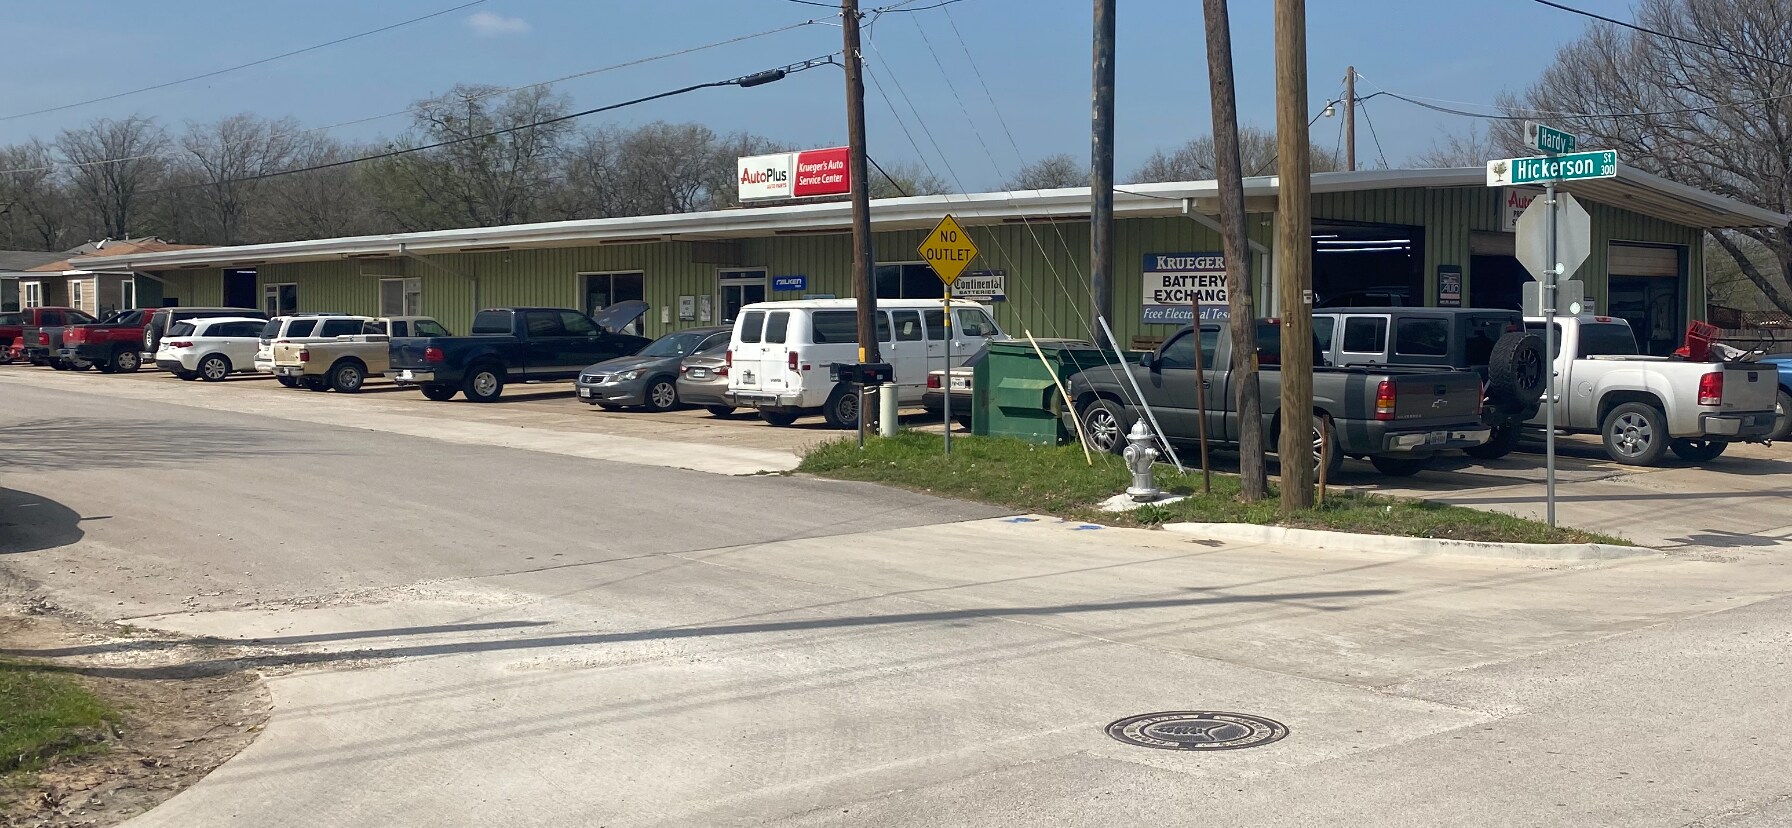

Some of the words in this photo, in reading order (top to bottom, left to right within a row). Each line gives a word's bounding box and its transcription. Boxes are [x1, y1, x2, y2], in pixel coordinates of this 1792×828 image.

[1541, 127, 1566, 153] Hardy
[798, 162, 828, 174] Krueger's
[828, 160, 844, 170] Auto
[1518, 158, 1594, 179] Hickerson
[1603, 152, 1612, 163] St
[1600, 164, 1615, 176] 300
[741, 167, 787, 184] AutoPlus
[799, 174, 821, 186] Service
[821, 173, 843, 184] Center
[940, 230, 957, 243] NO
[926, 247, 971, 261] OUTLET
[954, 276, 1003, 290] Continental
[1162, 275, 1227, 288] BATTERY
[1153, 289, 1227, 302] EXCHANG
[1143, 307, 1163, 319] Free
[1164, 306, 1210, 320] Electrial
